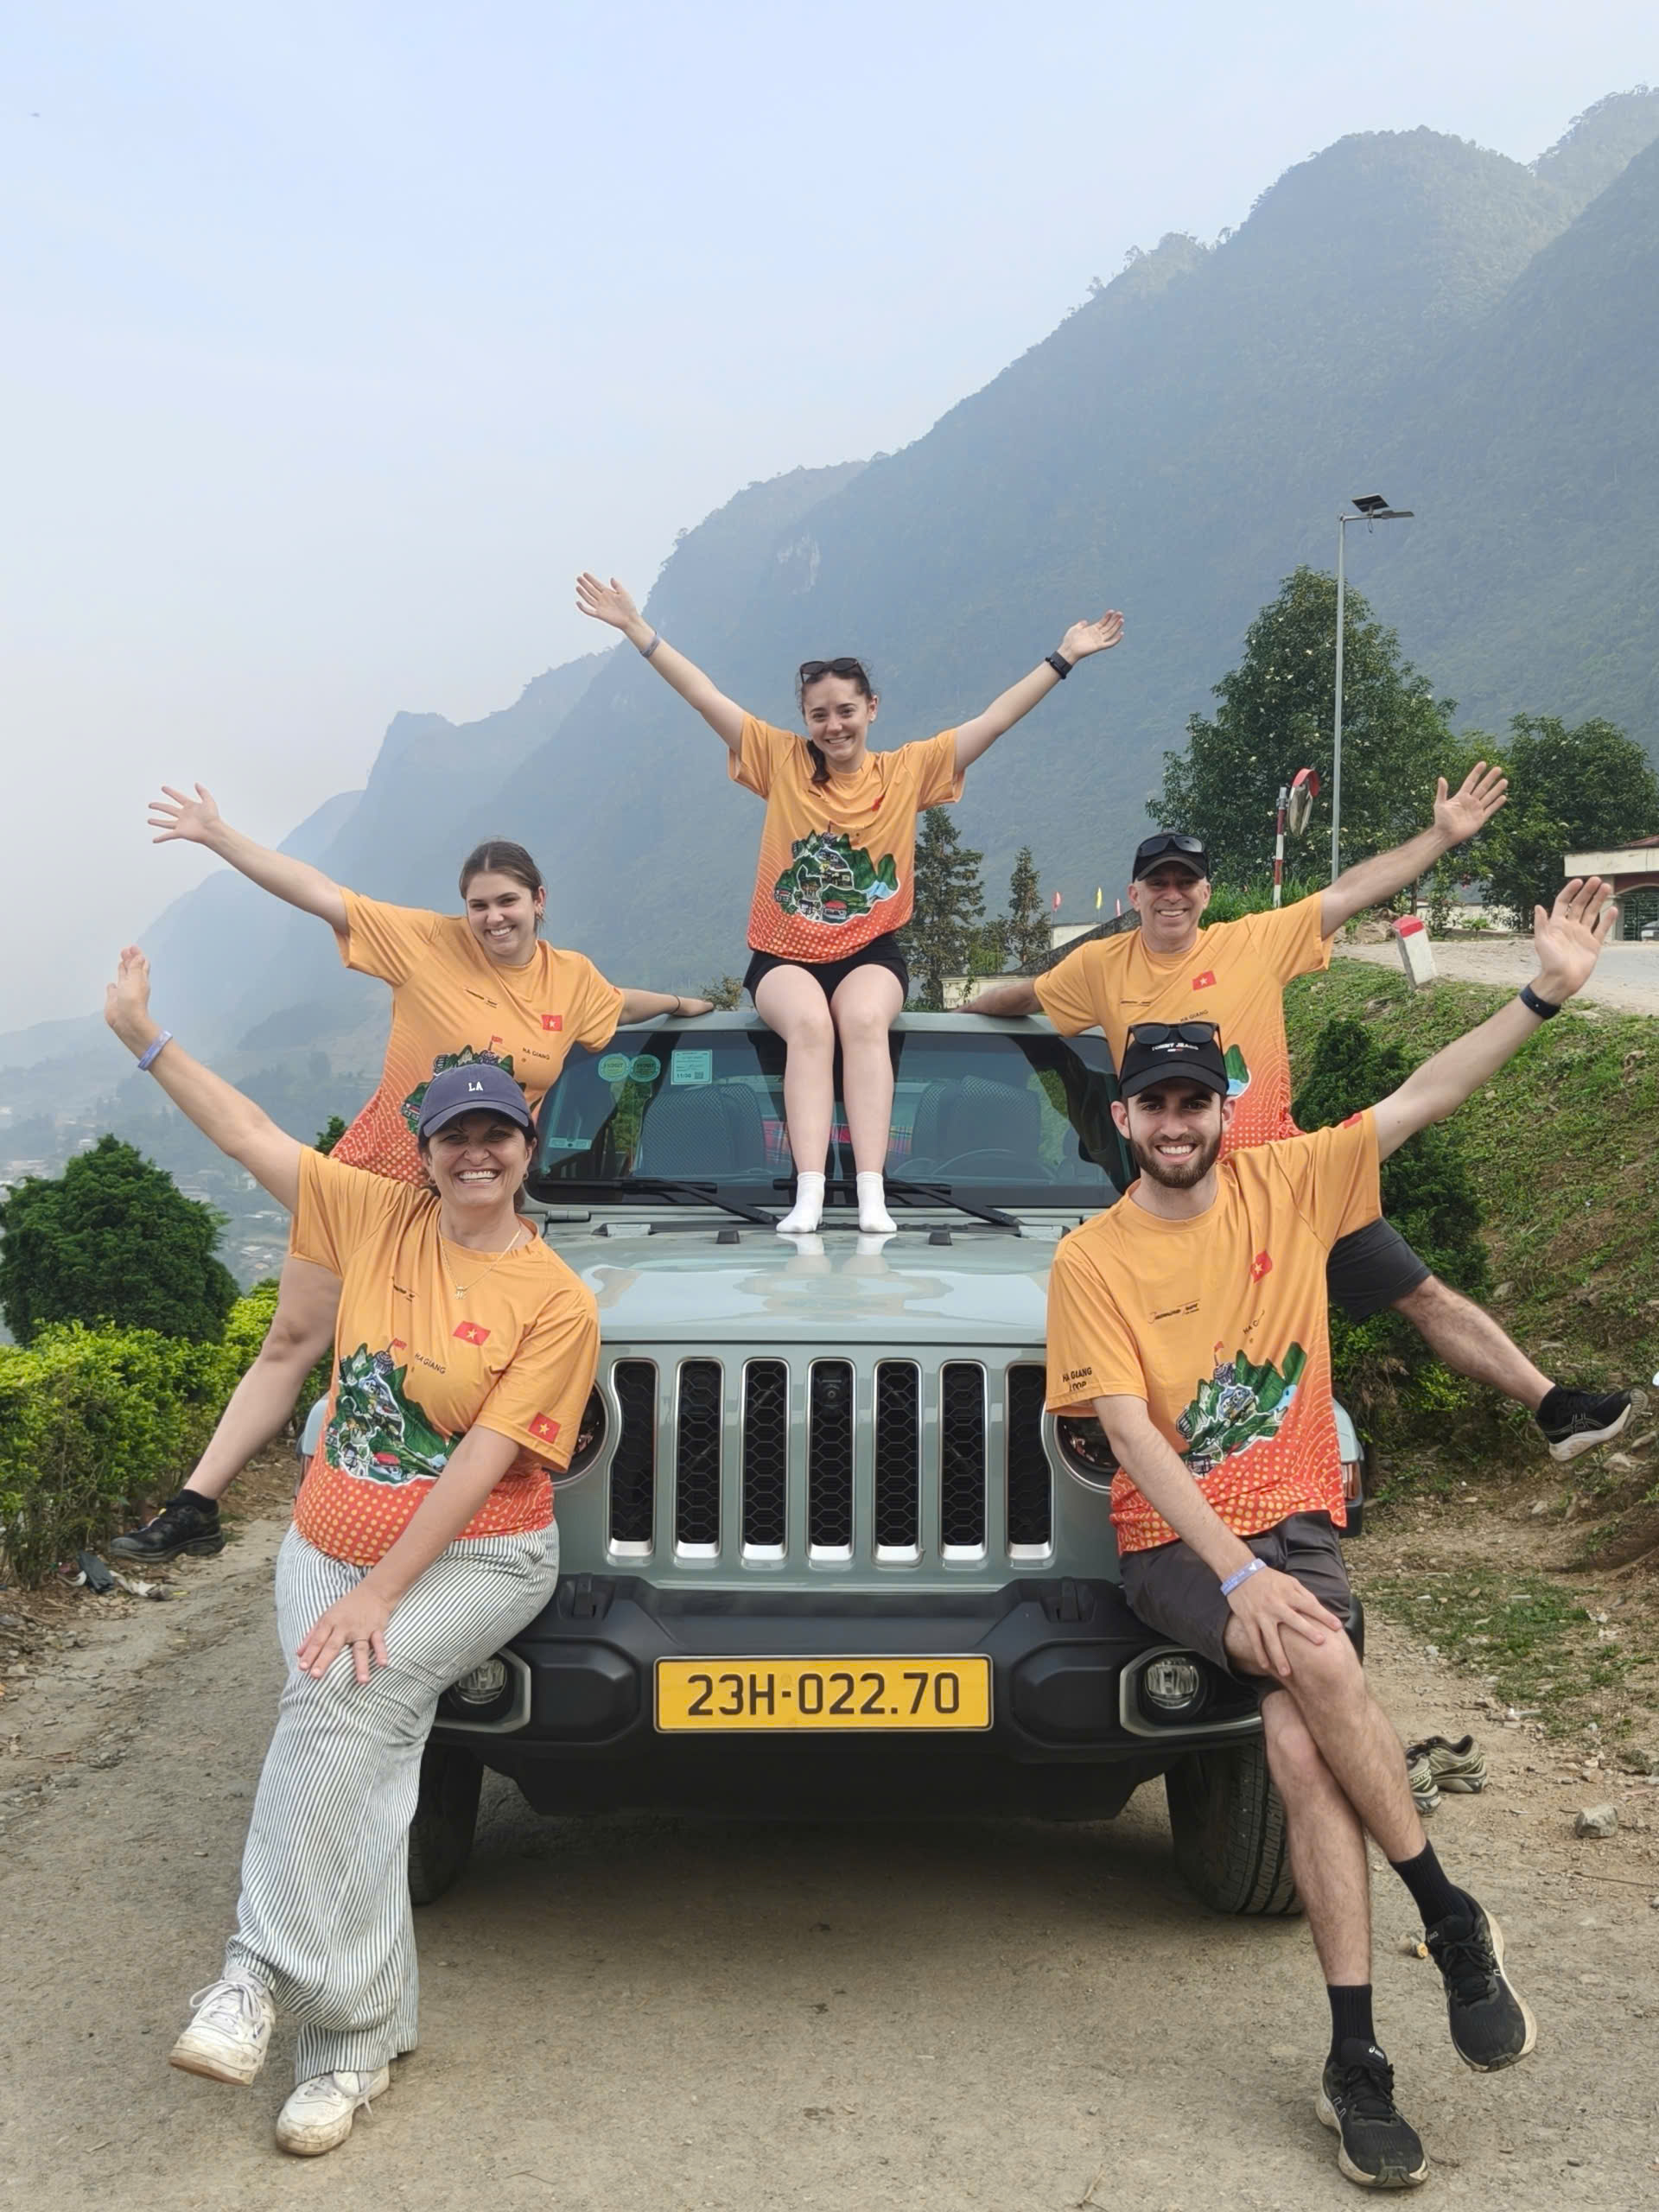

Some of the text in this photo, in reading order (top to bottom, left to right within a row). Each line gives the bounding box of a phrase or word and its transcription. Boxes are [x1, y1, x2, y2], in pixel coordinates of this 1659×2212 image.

[468, 1081, 484, 1092] LA
[423, 1357, 446, 1375] GIANG
[1071, 1366, 1092, 1380] GIANG
[687, 1671, 960, 1716] 23H-022.70
